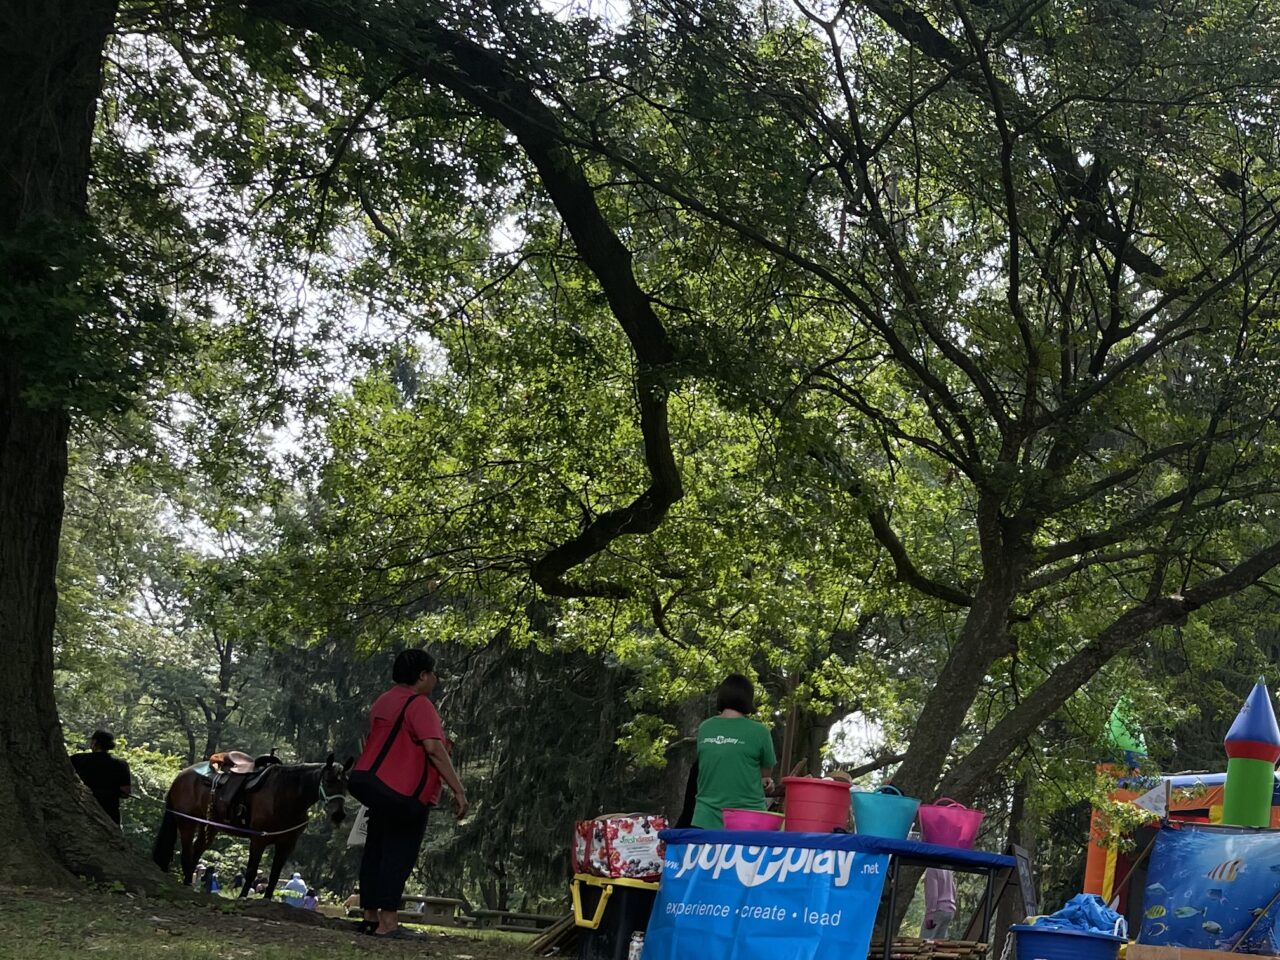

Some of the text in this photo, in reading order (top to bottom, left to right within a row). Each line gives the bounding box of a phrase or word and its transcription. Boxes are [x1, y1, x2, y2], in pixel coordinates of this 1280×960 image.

[860, 862, 879, 874] .net
[666, 901, 841, 926] experience create lead
